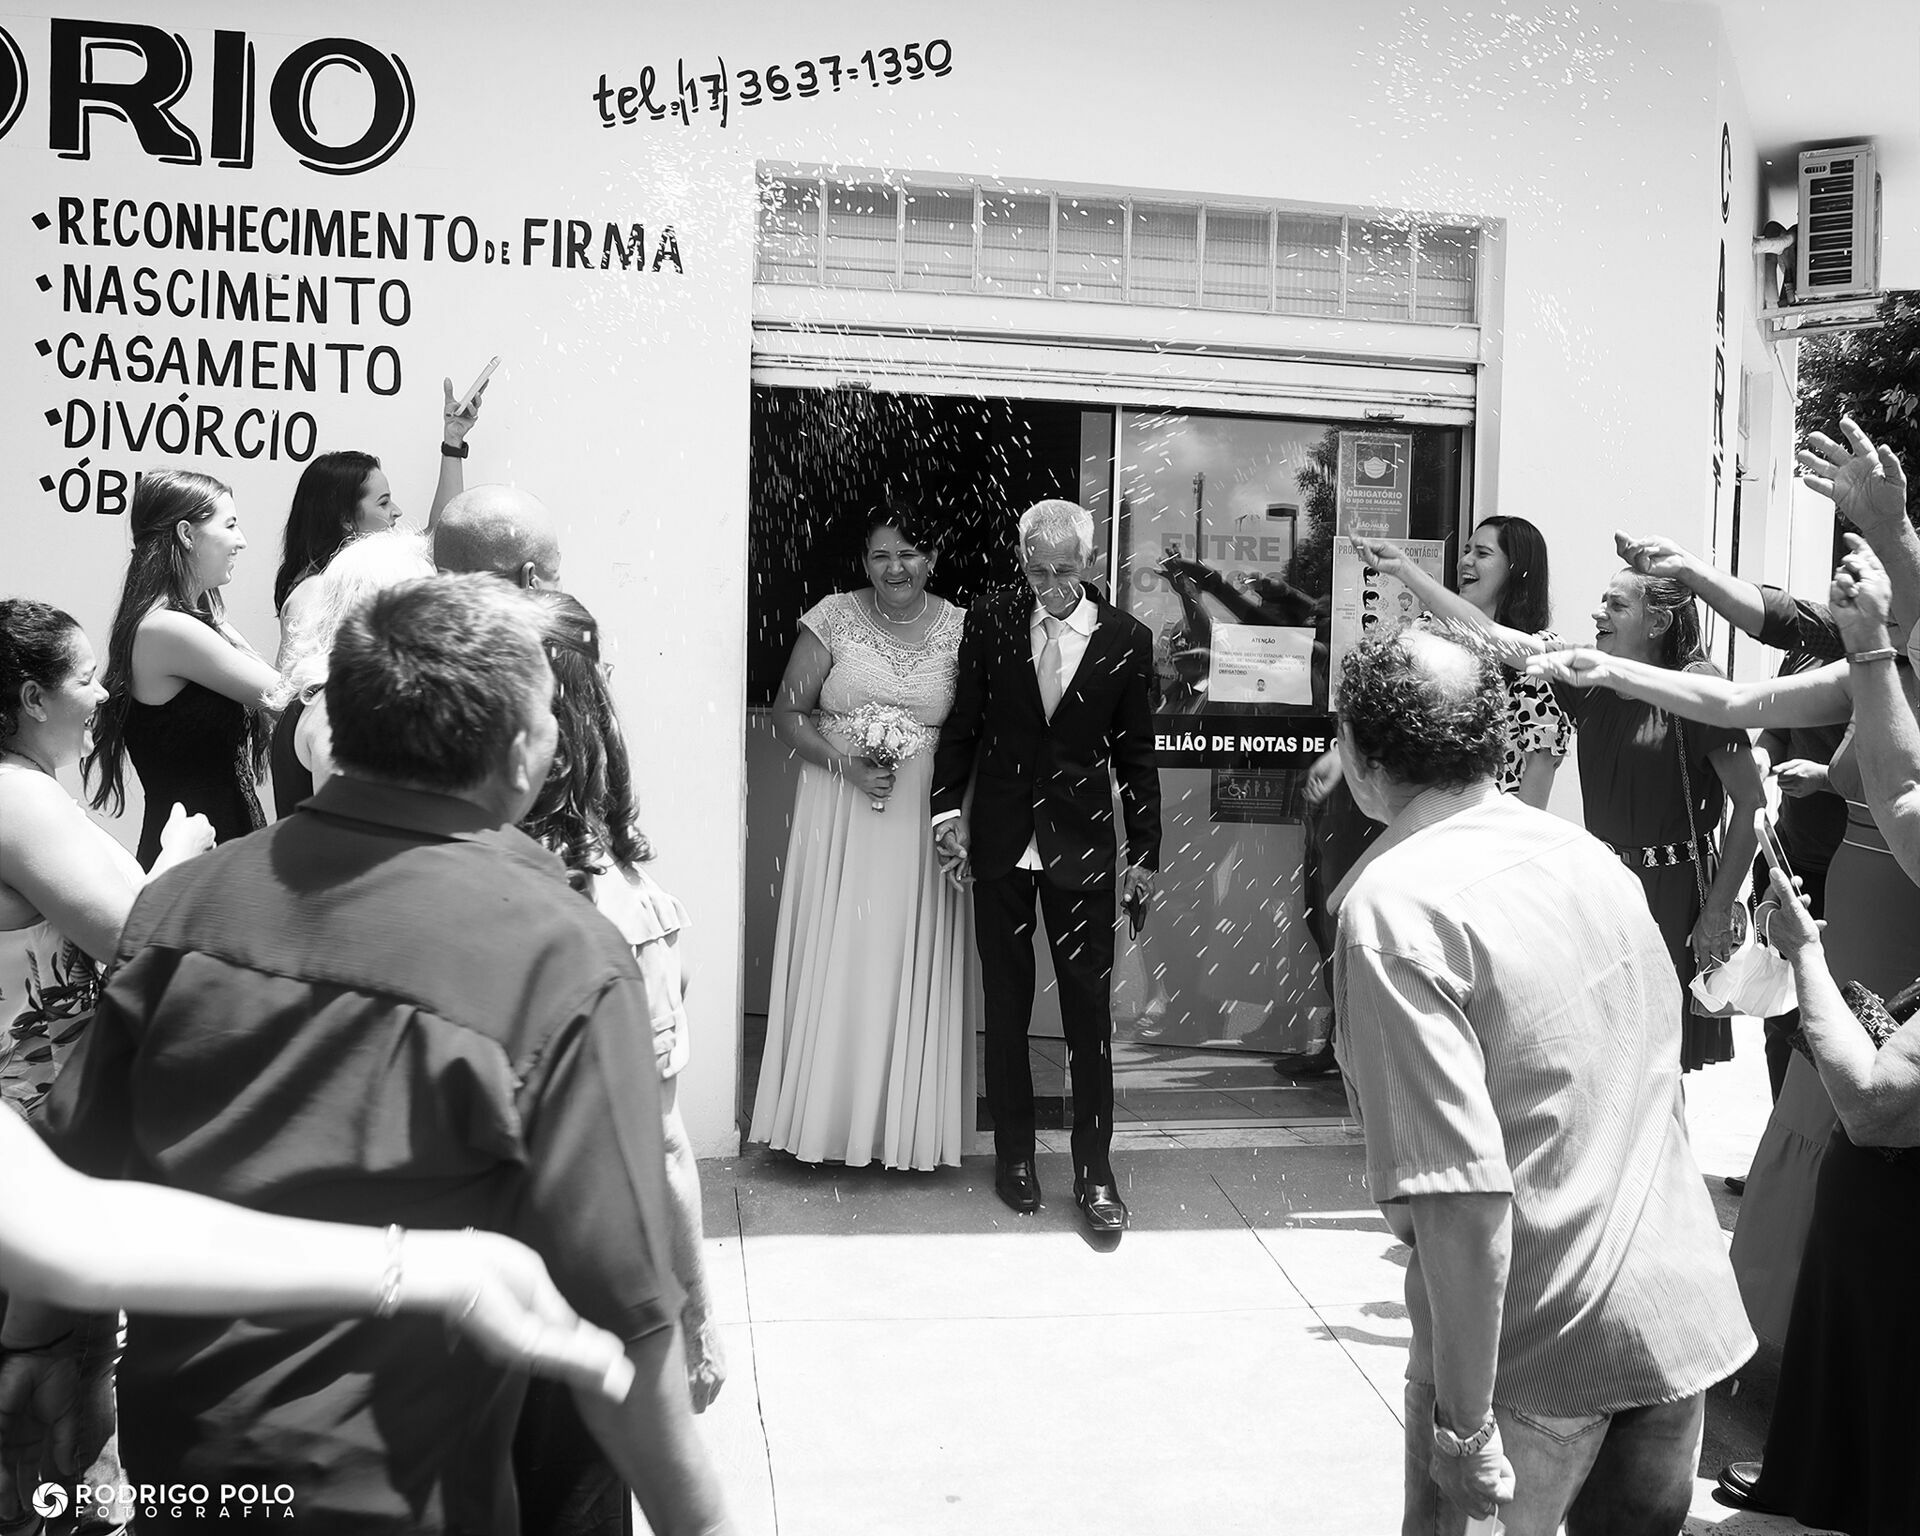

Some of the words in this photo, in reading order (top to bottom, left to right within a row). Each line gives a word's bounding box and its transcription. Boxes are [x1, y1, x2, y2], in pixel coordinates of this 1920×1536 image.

[0, 18, 416, 176] RIO
[58, 196, 479, 263] RECONHECIMENTO
[484, 239, 511, 265] DE
[522, 217, 684, 275] FIRMA
[62, 263, 412, 327] NASCIMENTO
[56, 332, 402, 396] CASAMENTO
[63, 392, 318, 462] DIVÓRCIO
[58, 456, 142, 515] ÓB
[1346, 489, 1403, 500] OBRIGATÓRIO
[1161, 533, 1281, 562] ENTRE
[1404, 546, 1439, 558] CONTÁGIO
[1251, 637, 1276, 645] ATENÇÃO
[1211, 735, 1235, 751] DE
[1240, 736, 1298, 752] NOTAS
[1302, 737, 1325, 753] DE
